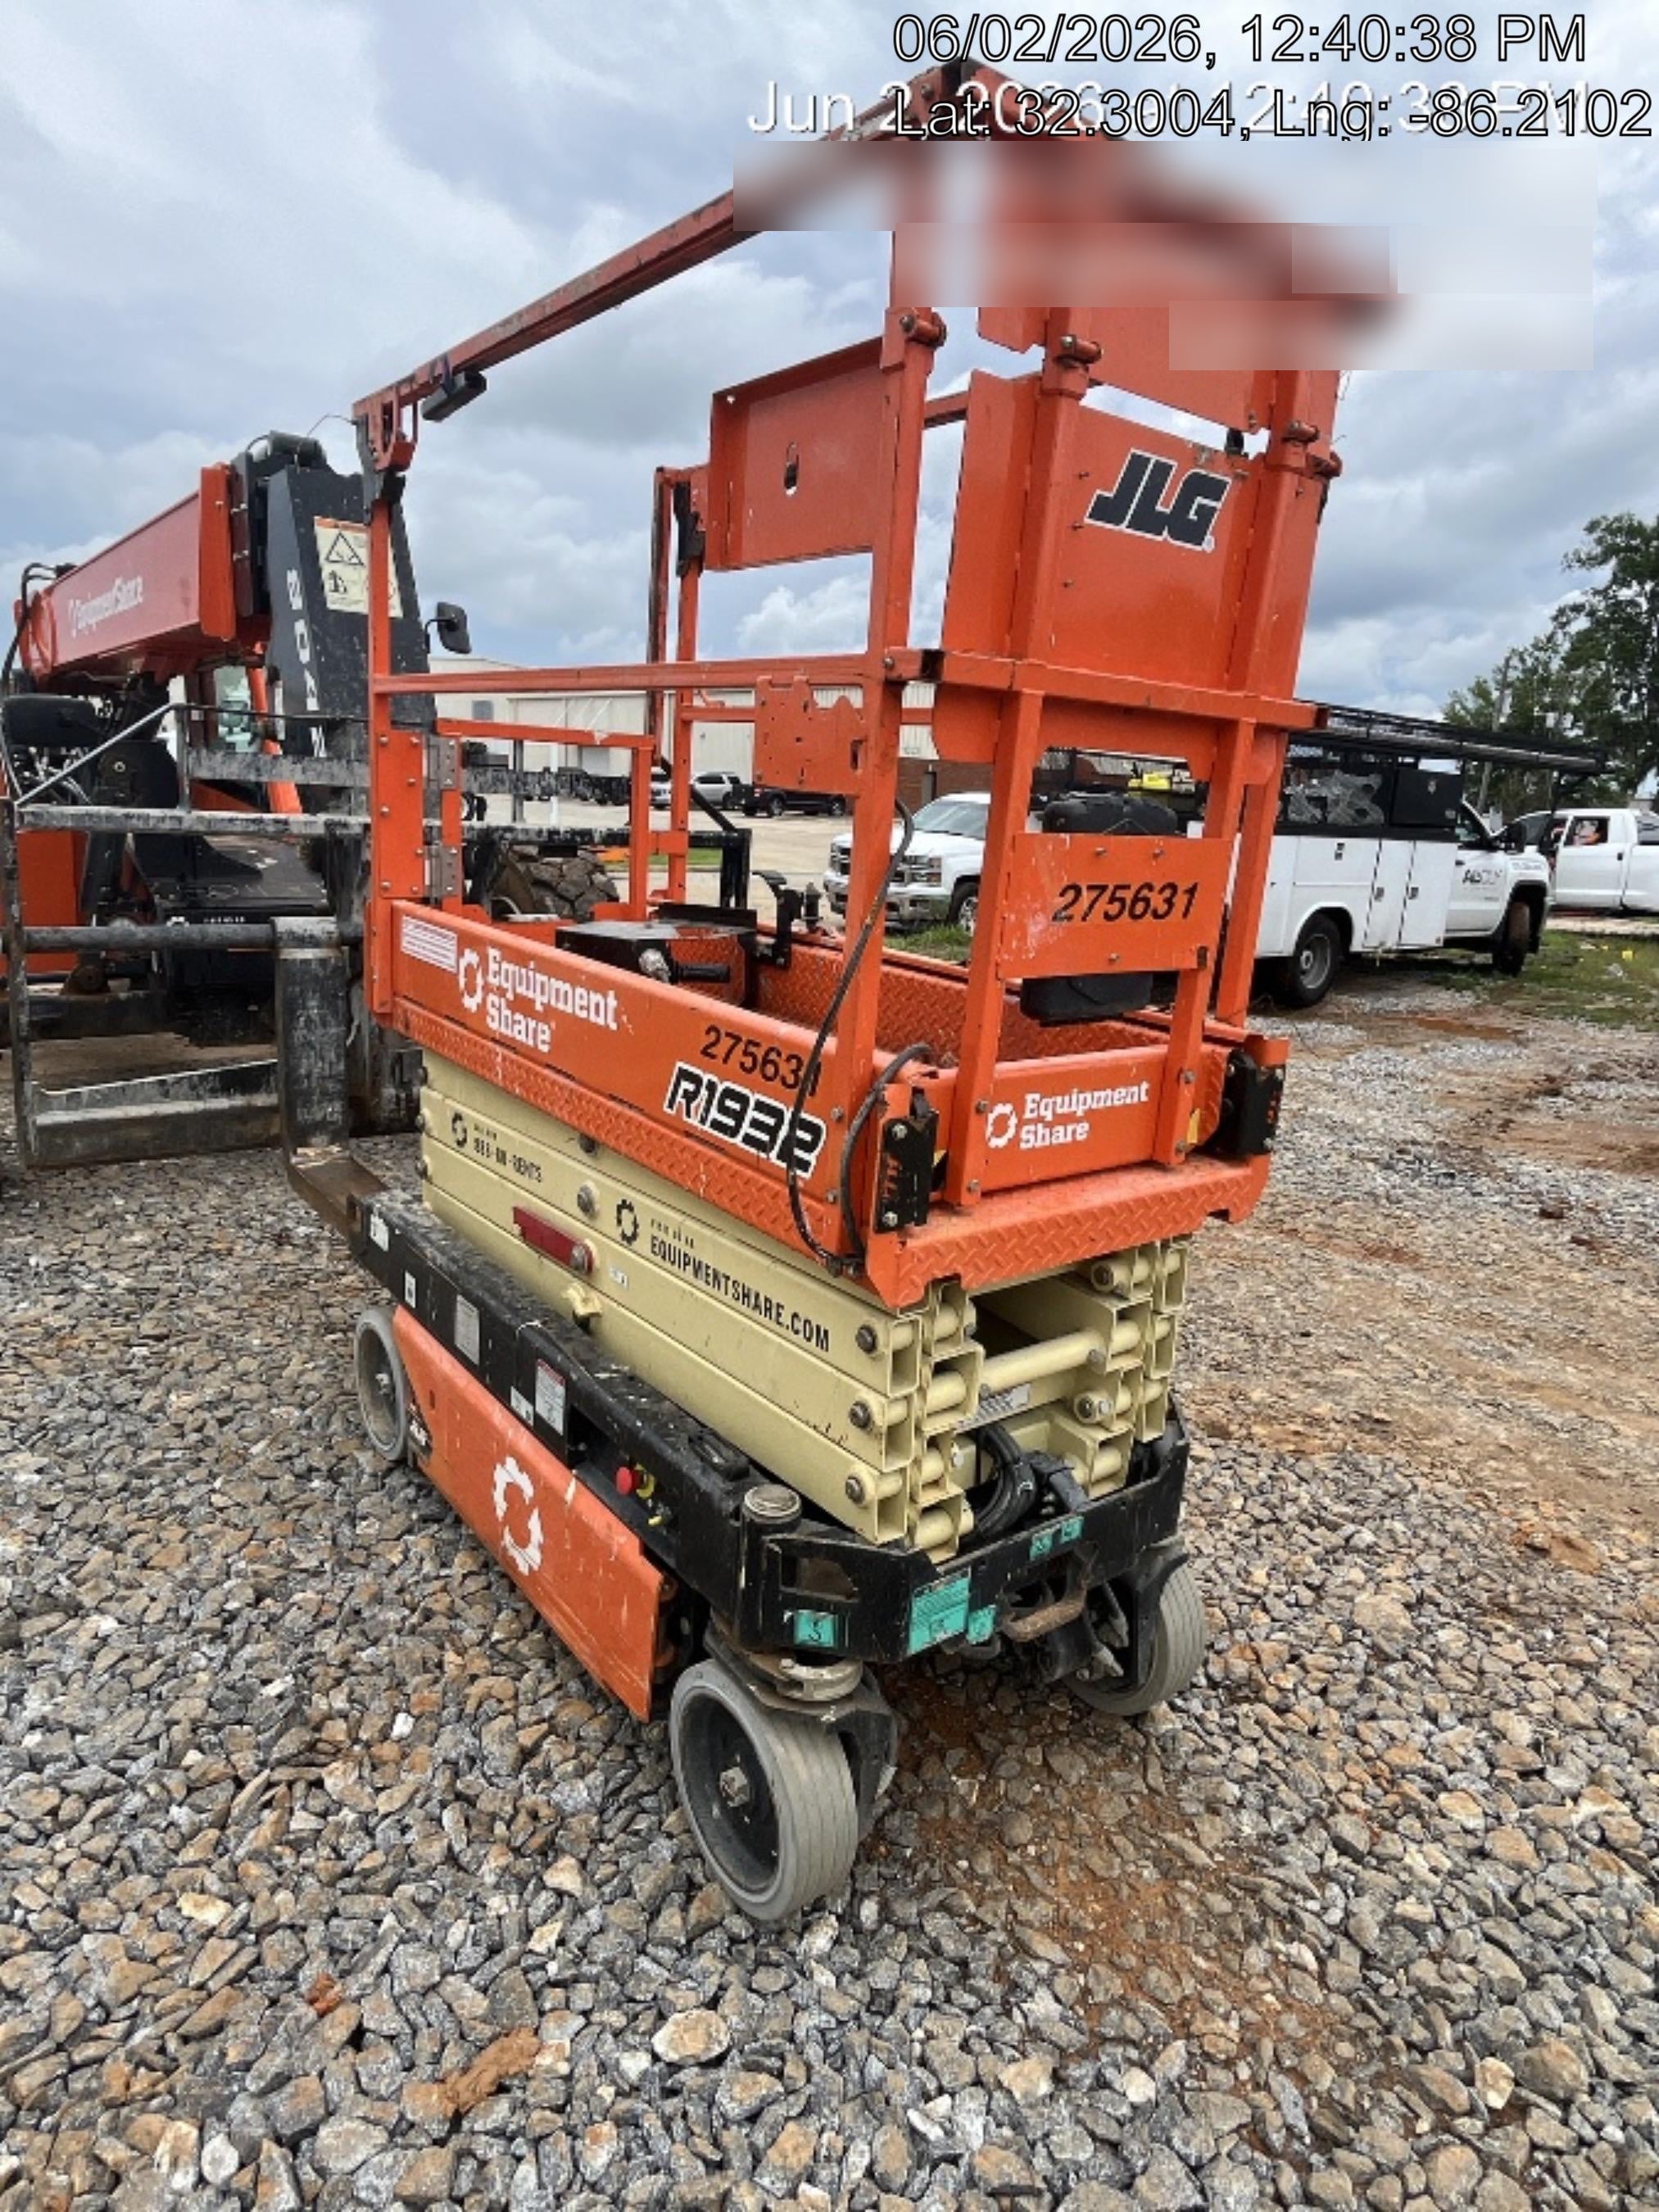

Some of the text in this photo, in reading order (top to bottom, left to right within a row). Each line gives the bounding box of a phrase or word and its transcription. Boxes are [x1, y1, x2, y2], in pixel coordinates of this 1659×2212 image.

[1084, 448, 1231, 553] JLG
[1052, 882, 1199, 922] 275631
[486, 945, 619, 1031] Equipment
[486, 991, 552, 1054] Share
[664, 1062, 827, 1180] R1932
[1019, 1121, 1090, 1150] Share
[1022, 1080, 1149, 1122] Equipment
[650, 1235, 830, 1353] EQUIPMENTSHARE.COM
